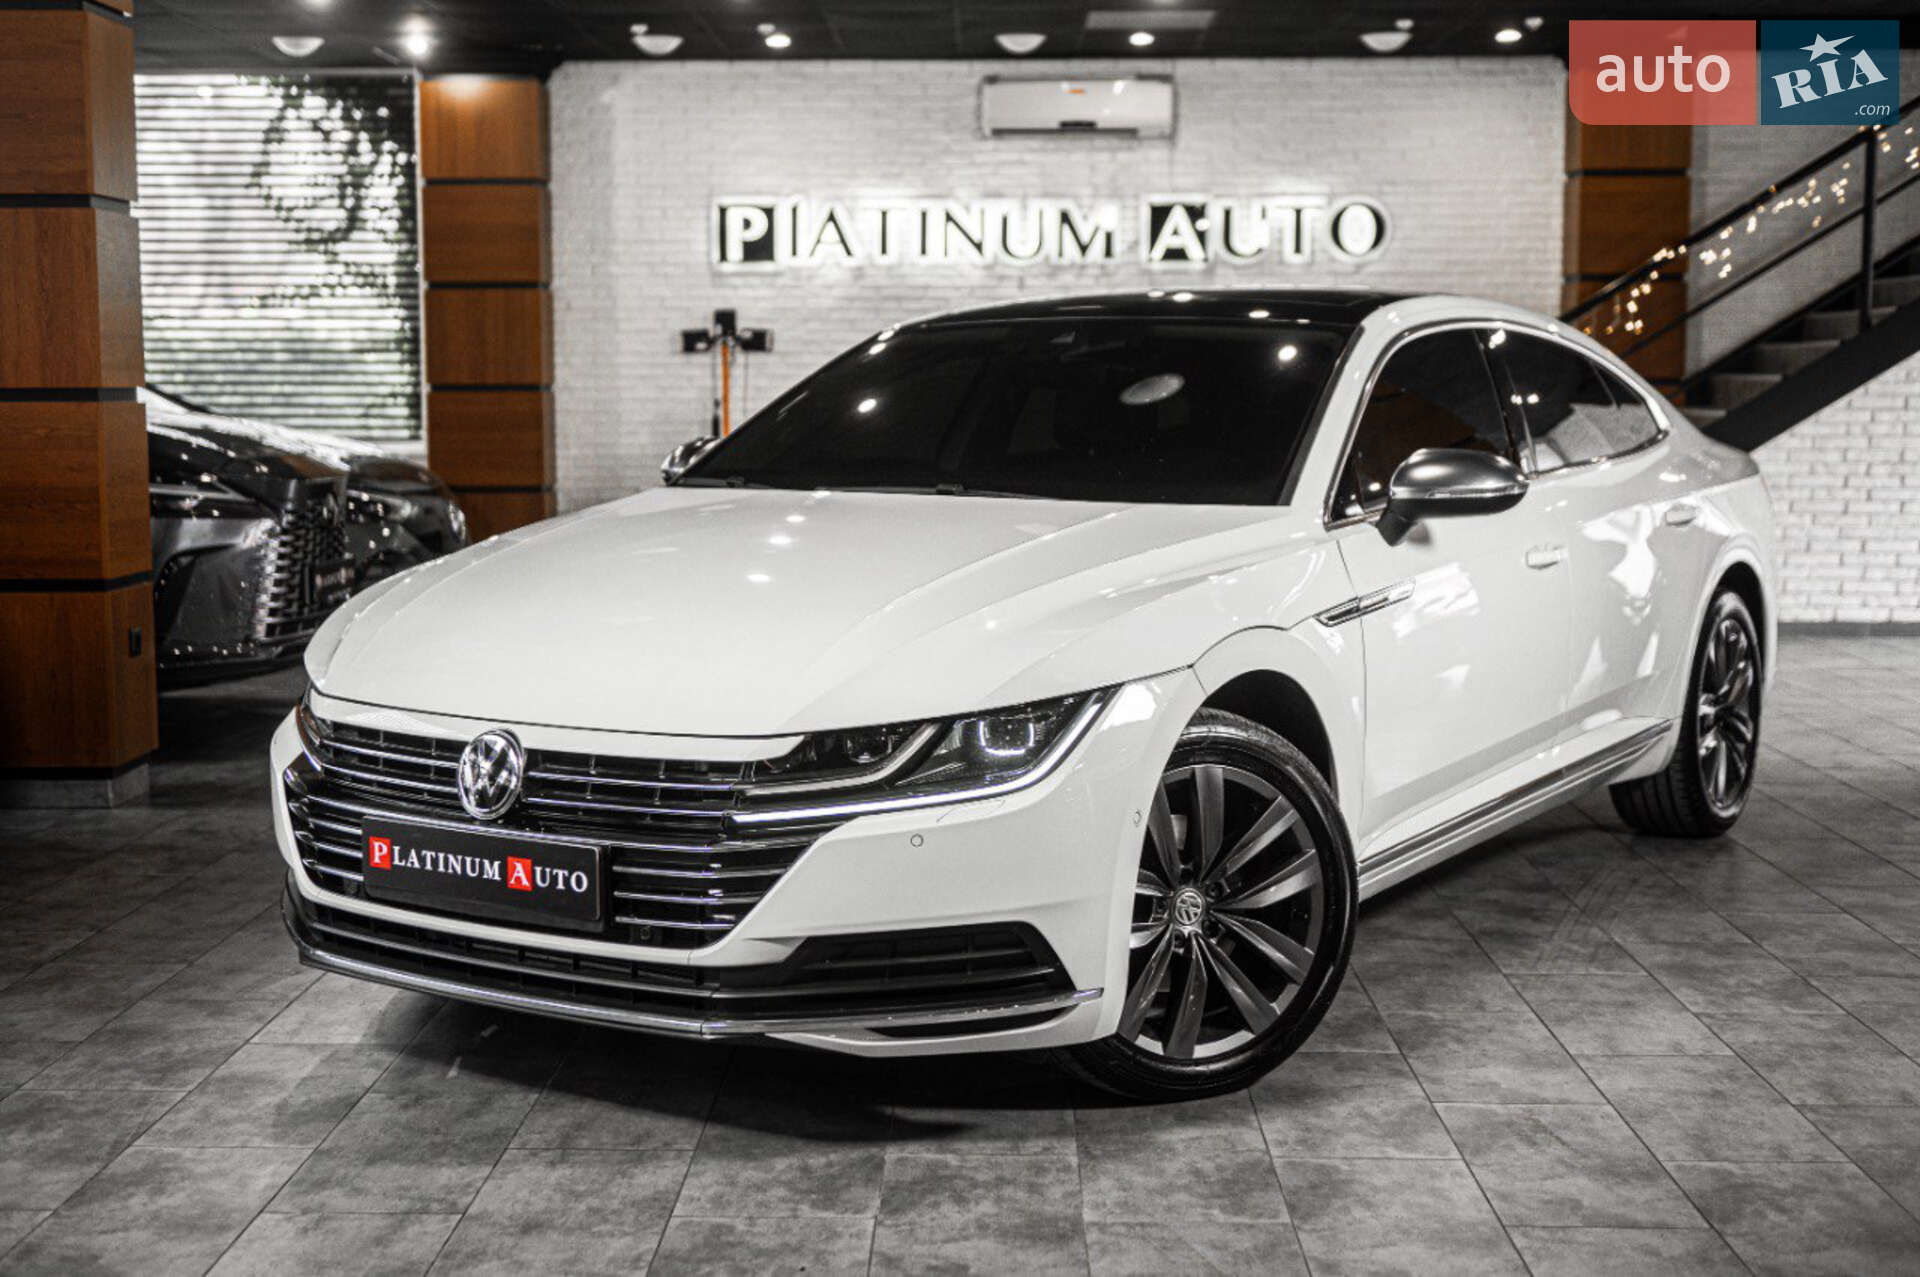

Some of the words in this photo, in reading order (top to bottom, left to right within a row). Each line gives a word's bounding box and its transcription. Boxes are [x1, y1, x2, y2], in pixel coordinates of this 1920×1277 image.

[1149, 202, 1387, 262] AUTO
[372, 840, 502, 881] PLATINUM
[509, 860, 588, 892] AUTO
